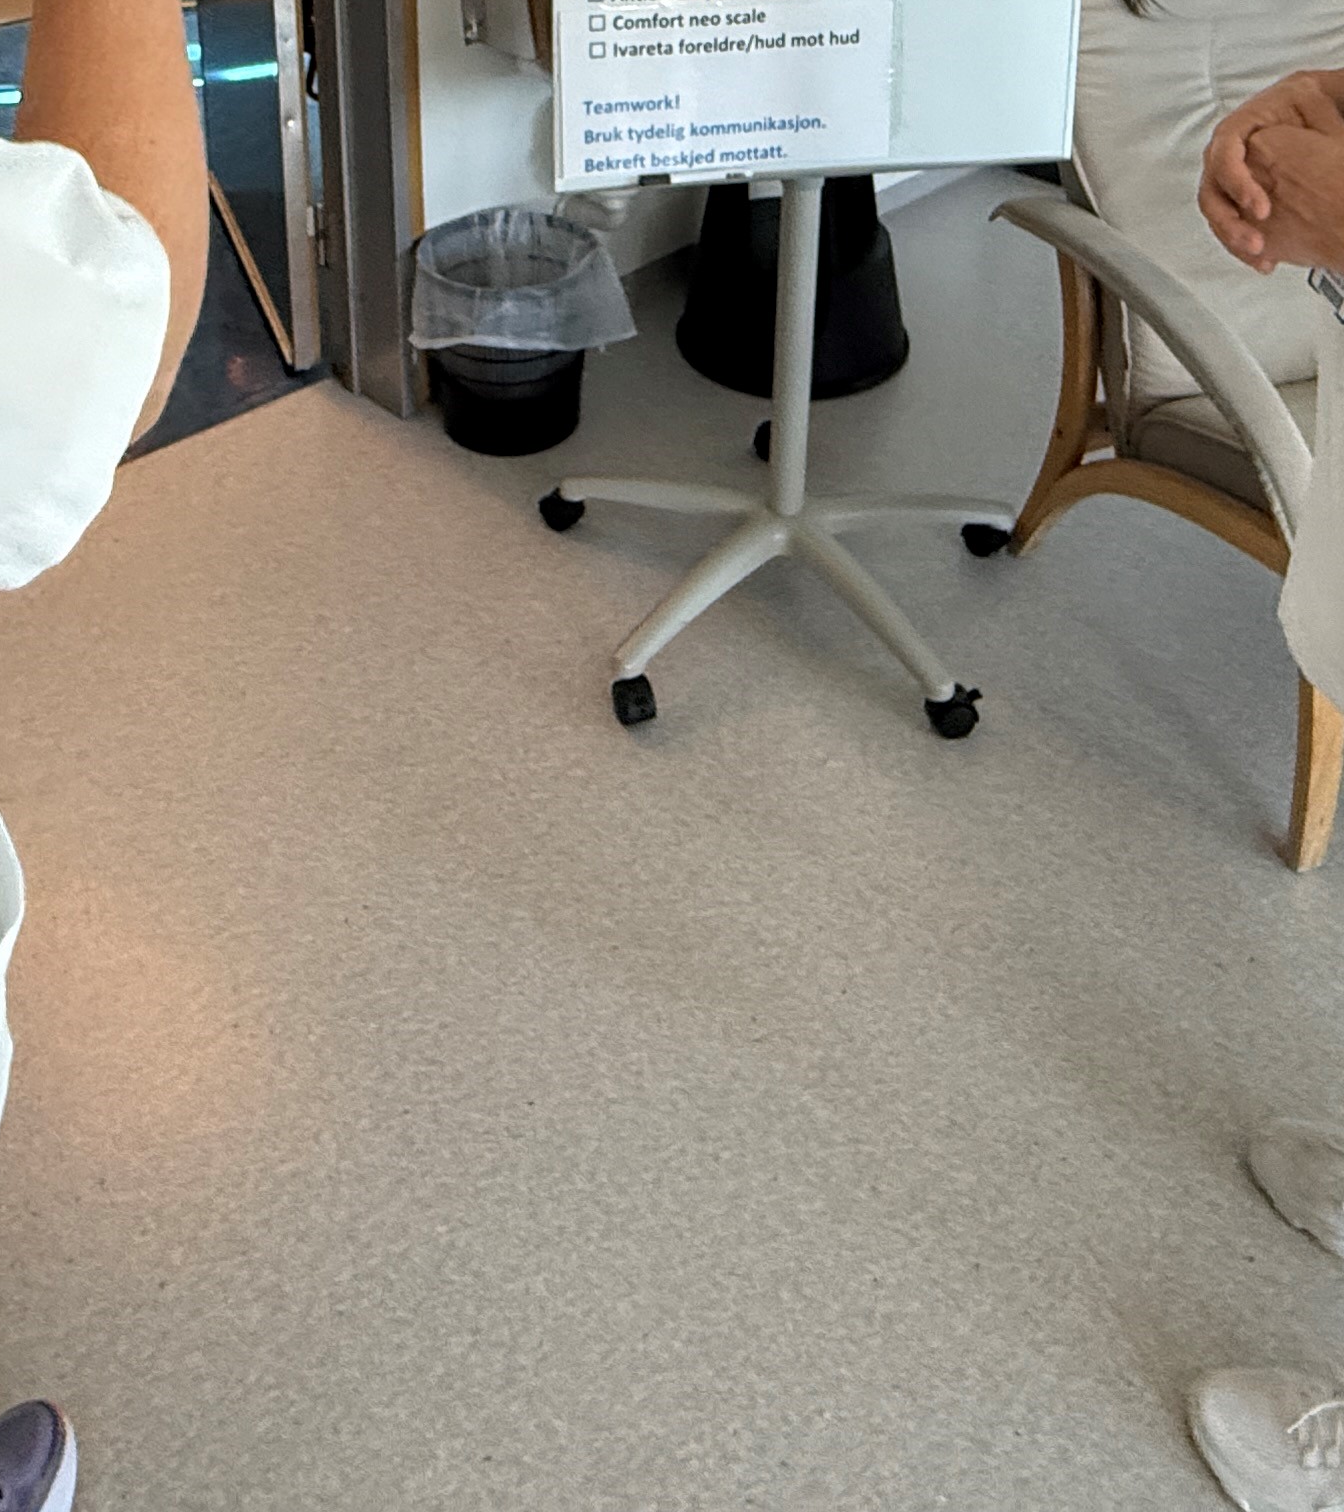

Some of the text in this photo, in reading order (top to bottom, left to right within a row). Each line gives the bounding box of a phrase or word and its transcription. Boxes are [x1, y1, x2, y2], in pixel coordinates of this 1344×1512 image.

[613, 9, 766, 31] Comfort neo scale
[613, 29, 859, 58] Ivareta foreldre/hud mot hud
[584, 95, 680, 115] Teamwork!
[584, 115, 826, 144] Bruk tydelig kommunikasjon.
[585, 145, 787, 172] Bekreft beskjed mottatt.
